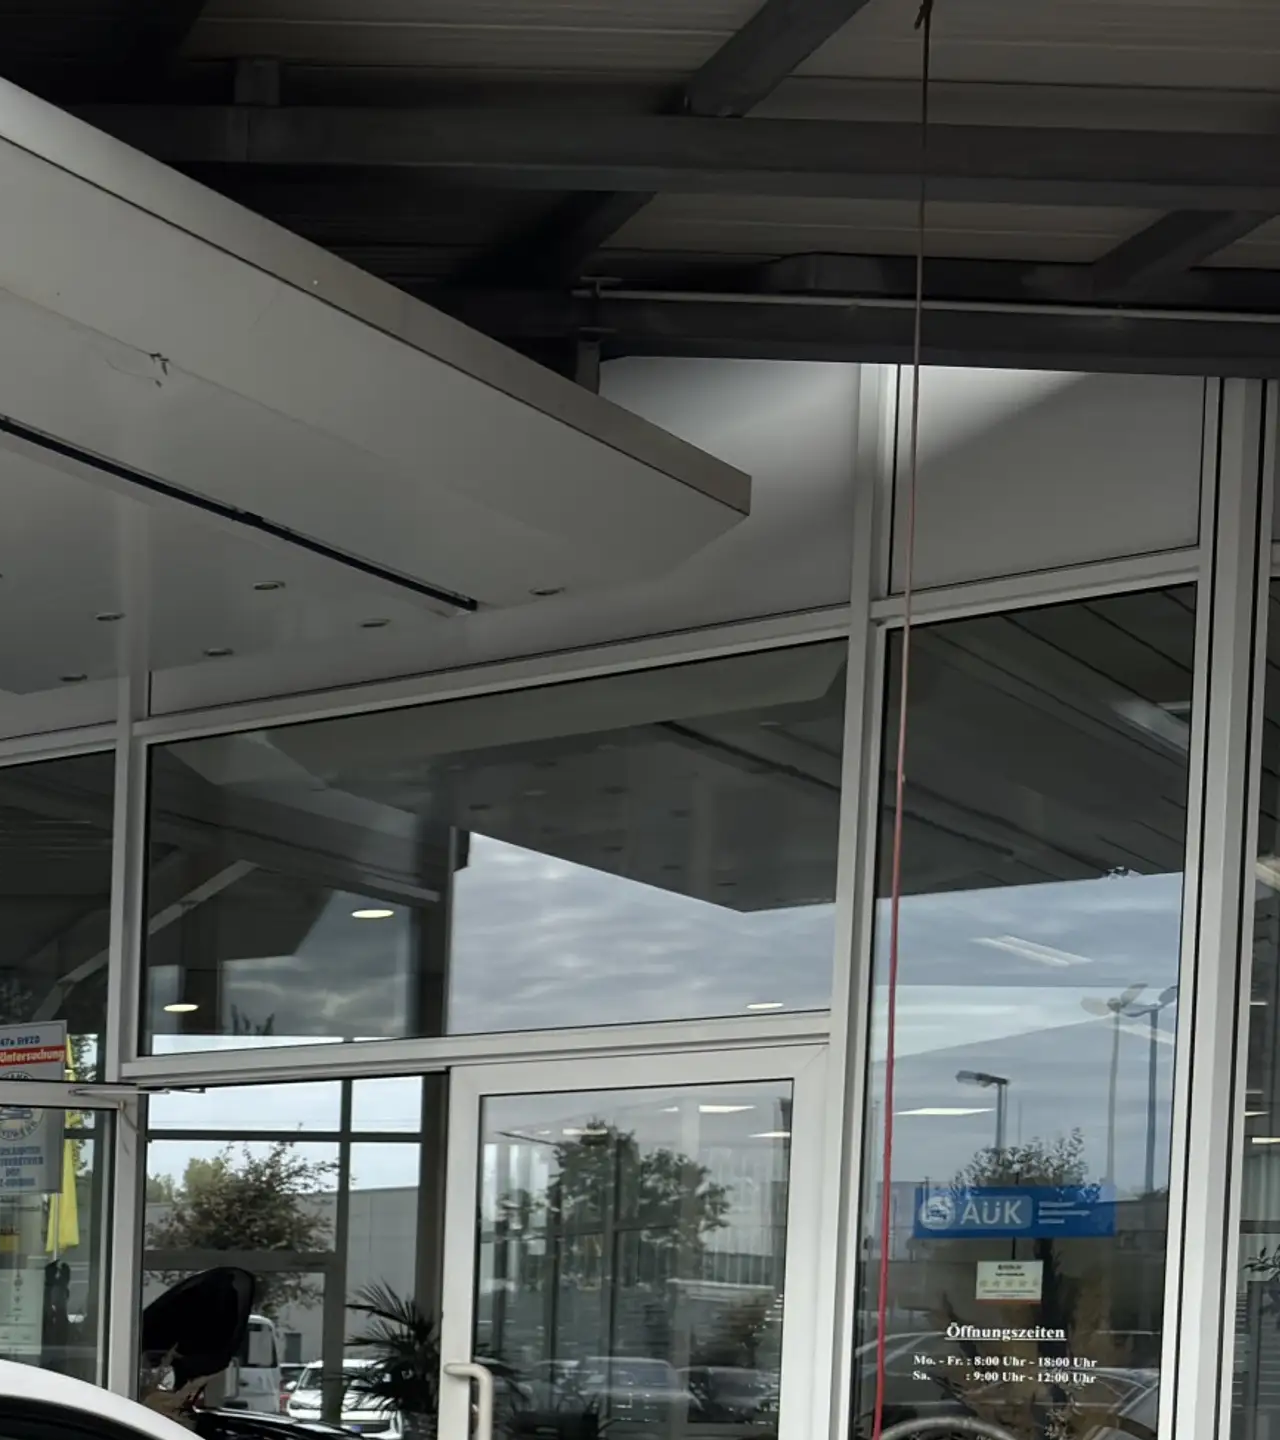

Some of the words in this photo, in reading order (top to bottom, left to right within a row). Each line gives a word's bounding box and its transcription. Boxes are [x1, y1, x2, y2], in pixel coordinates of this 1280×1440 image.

[946, 1322, 1065, 1341] Öffnungszeiten
[913, 1355, 936, 1366] Mo.
[947, 1356, 964, 1366] Fr.
[974, 1356, 1000, 1366] 8:00
[1002, 1356, 1027, 1367] Uhr
[1038, 1357, 1070, 1367] 18:00
[1073, 1357, 1098, 1368] Uhr
[912, 1370, 931, 1380] Sa.
[973, 1371, 999, 1381] 9:00
[1002, 1371, 1026, 1382] Uhr
[1038, 1372, 1069, 1382] 12:00
[1072, 1372, 1096, 1383] Uhr
